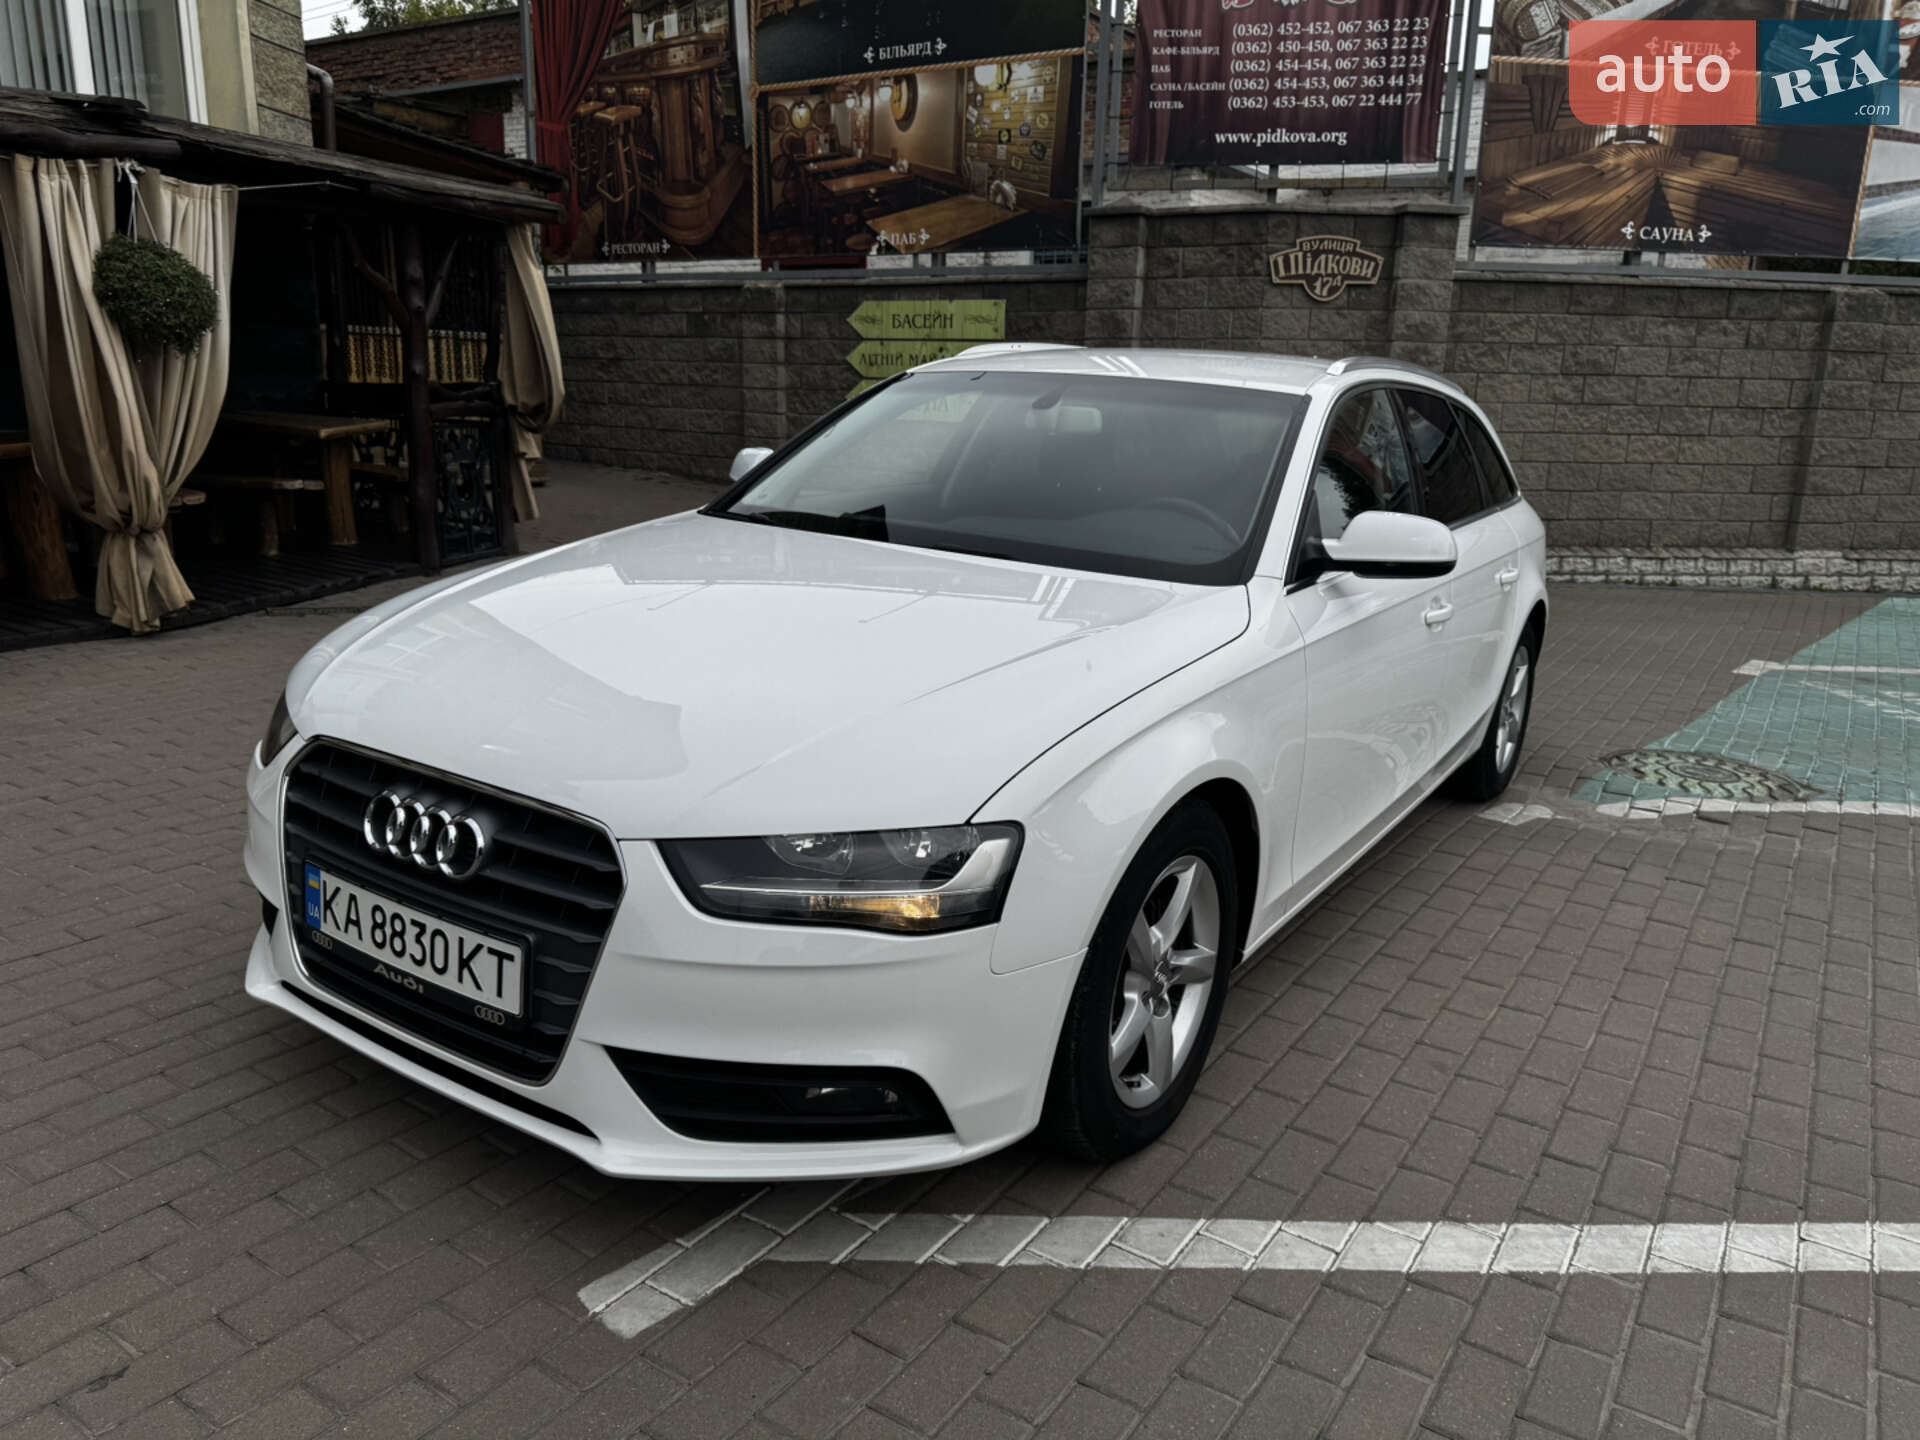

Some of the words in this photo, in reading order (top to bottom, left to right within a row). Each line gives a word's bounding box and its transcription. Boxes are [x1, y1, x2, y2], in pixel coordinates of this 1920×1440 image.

[1153, 29, 1202, 38] РЕСТОРАН
[1233, 22, 1272, 38] (0362)
[1277, 21, 1334, 36] 452-452,
[1338, 20, 1362, 34] 067
[1365, 19, 1389, 33] 363
[1393, 18, 1409, 32] 22
[1412, 17, 1429, 31] 23
[879, 41, 932, 60] БІЛЬЯРД
[1231, 40, 1272, 56] (0362)
[1276, 39, 1333, 54] 450-450,
[1337, 38, 1361, 51] 067
[1364, 37, 1388, 51] 363
[1392, 37, 1408, 49] 22
[1411, 36, 1428, 48] 23
[1151, 64, 1171, 73] ПАБ
[1230, 58, 1271, 74] (0362)
[1275, 58, 1332, 72] 454-454,
[1335, 57, 1359, 70] 067
[1362, 56, 1386, 69] 363
[1390, 55, 1406, 68] 22
[1409, 54, 1426, 67] 23
[1229, 77, 1269, 93] (0362)
[1274, 76, 1330, 91] 454-453,
[1333, 76, 1357, 89] 067
[1361, 75, 1384, 88] 363
[1387, 74, 1404, 87] 44
[1407, 73, 1424, 86] 34
[1149, 101, 1184, 109] ГОТЕЛЬ
[1227, 96, 1268, 111] (0362)
[1273, 95, 1329, 109] 453-453,
[1332, 95, 1356, 107] 067
[1359, 94, 1375, 106] 22
[1378, 93, 1402, 106] 444
[1406, 93, 1422, 105] 77
[1215, 128, 1348, 146] www.pidkova.org
[891, 232, 917, 246] ПАБ
[1640, 225, 1694, 244] САУНА
[611, 242, 660, 254] РЕСТОРАН
[1302, 240, 1354, 253] ВУЛИЦЯ
[892, 311, 953, 329] БАСЕЙН
[859, 352, 903, 367] ЛІТНІЙ
[308, 902, 320, 920] UA
[373, 963, 424, 994] Audi
